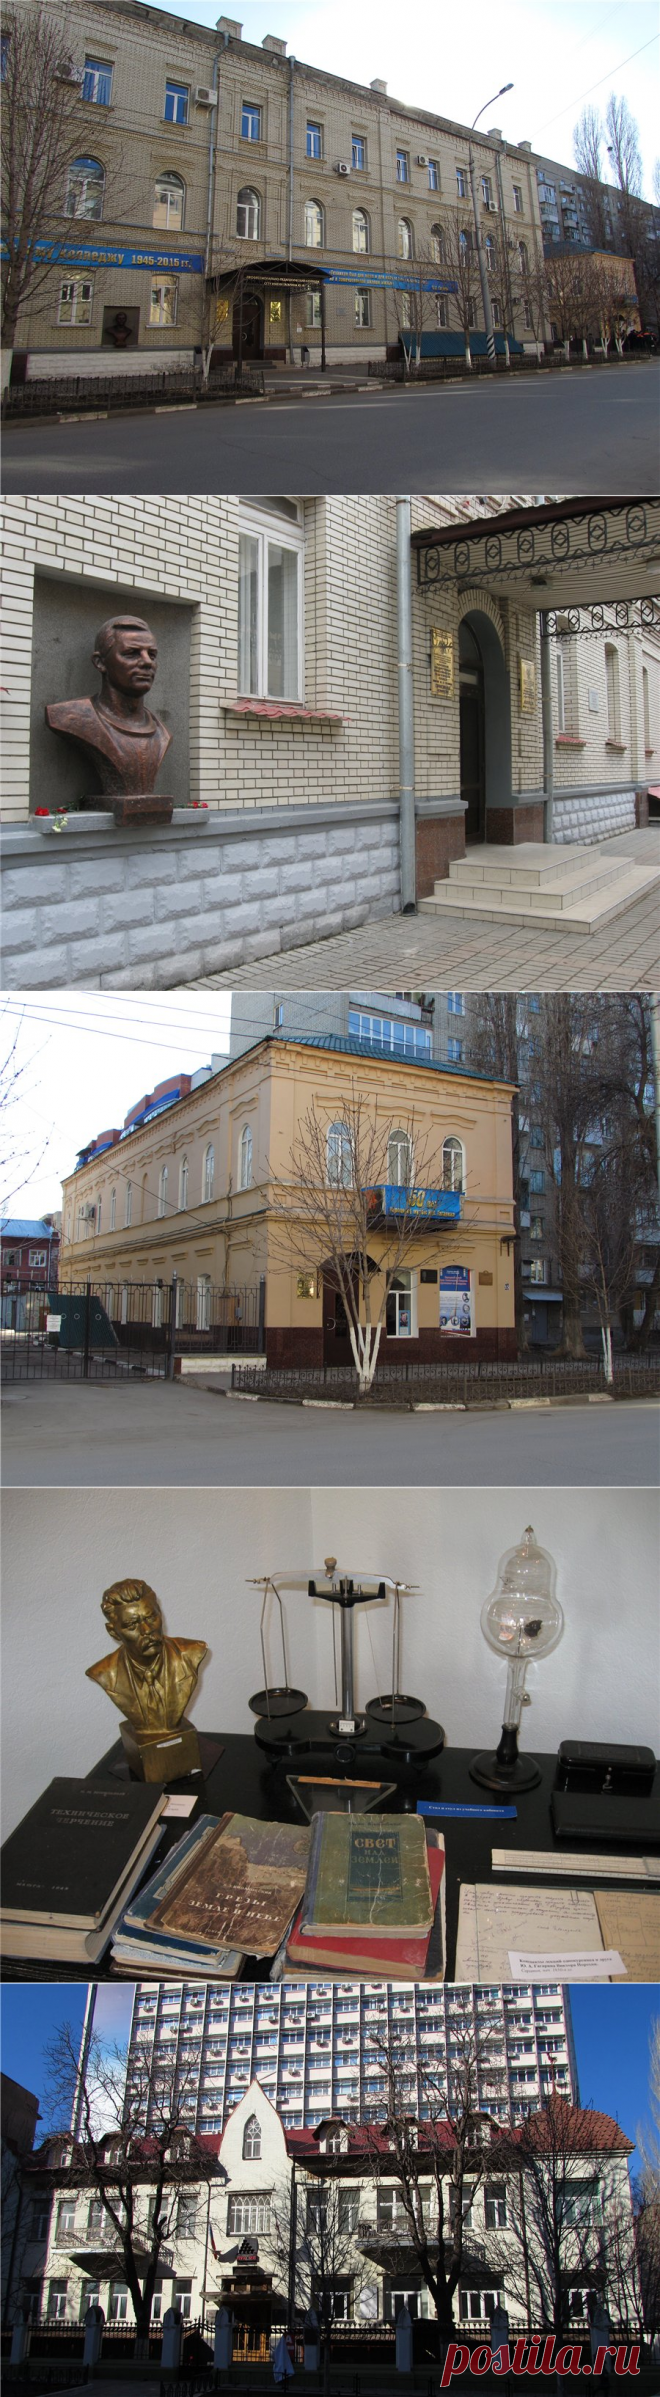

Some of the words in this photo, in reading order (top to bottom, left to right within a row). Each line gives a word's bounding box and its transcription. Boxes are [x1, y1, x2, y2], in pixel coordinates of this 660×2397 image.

[131, 254, 180, 267] 1945-2015
[409, 1189, 426, 1208] 50
[50, 1808, 130, 1820] ТЕХНИЧЕСКОЕ
[56, 1817, 115, 1827] ЧЕРЧЕНИЕ
[188, 1899, 230, 1913] ЗЕМЛЕ
[245, 1911, 283, 1922] НЕБЕ
